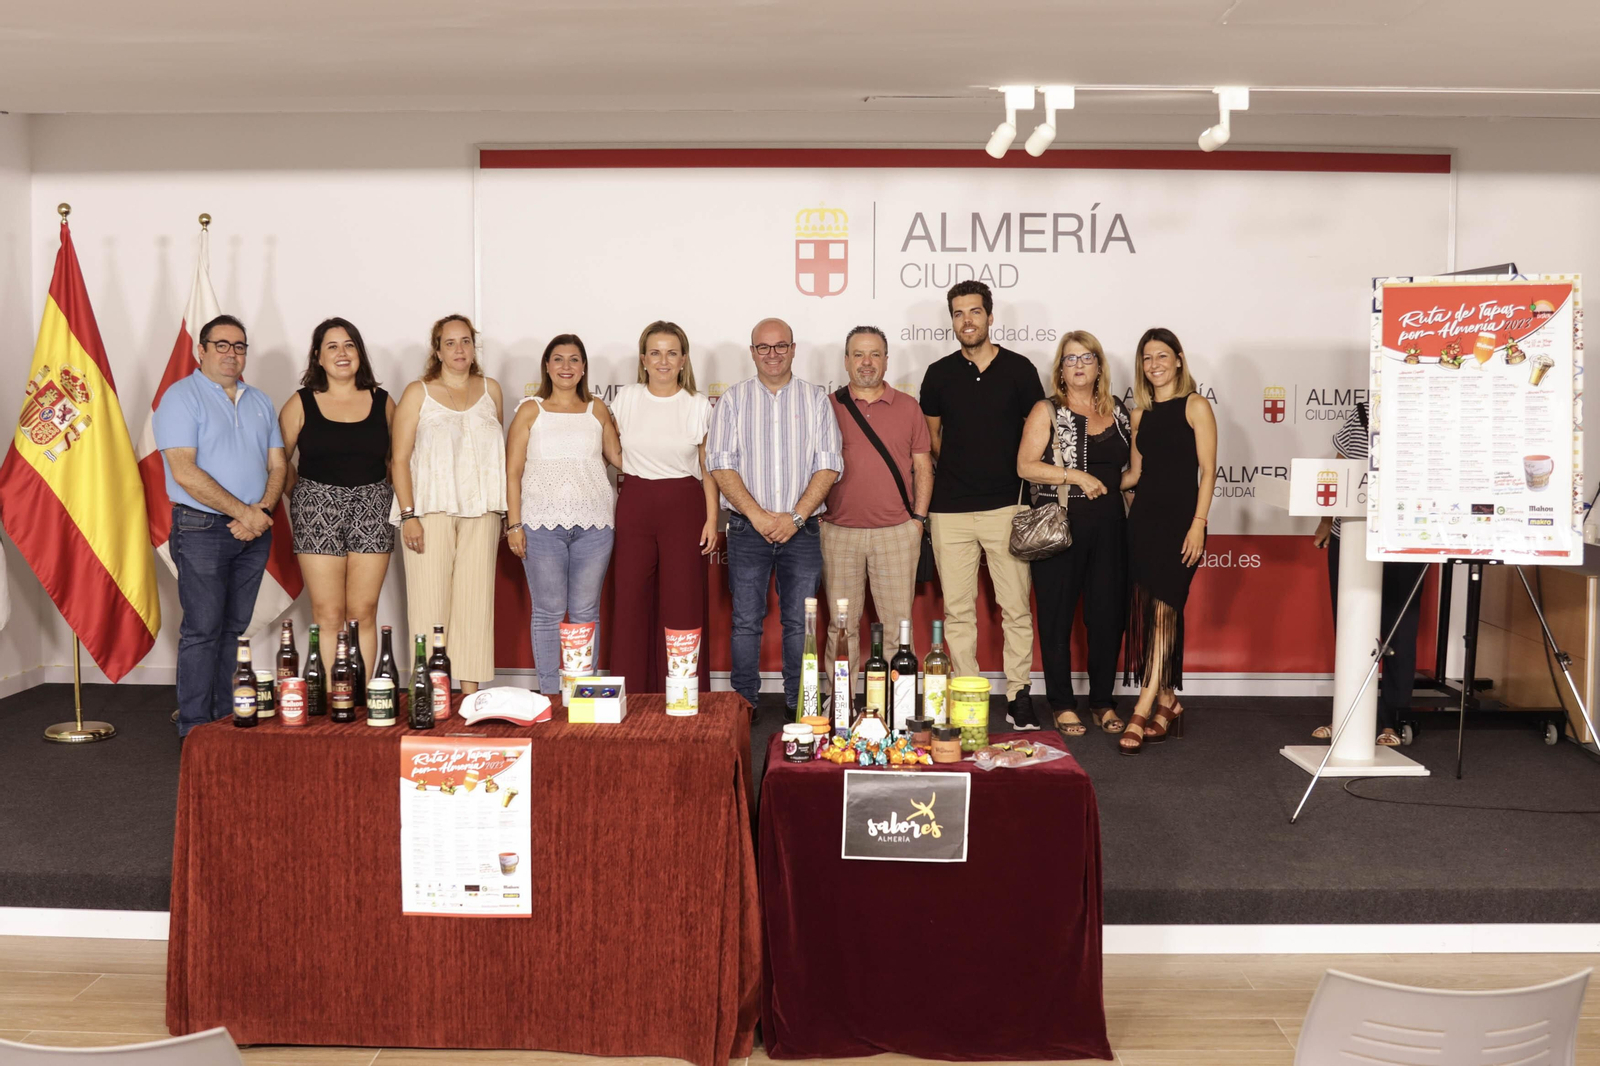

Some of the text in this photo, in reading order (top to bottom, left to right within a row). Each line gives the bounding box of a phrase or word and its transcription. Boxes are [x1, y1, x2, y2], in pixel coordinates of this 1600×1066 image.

[900, 202, 1137, 254] ALMERÍA
[900, 262, 1019, 289] CIUDAD
[1398, 305, 1452, 328] Ruta
[1454, 302, 1476, 322] de
[1478, 300, 1526, 319] Tapas
[1397, 327, 1435, 346] por
[1437, 319, 1505, 338] Almería
[1306, 388, 1370, 406] ALME
[1215, 466, 1288, 483] ALMER
[1213, 486, 1256, 498] CIUDA
[367, 698, 393, 709] MAGNA
[411, 750, 449, 766] Ruta
[867, 811, 943, 839] sabores
